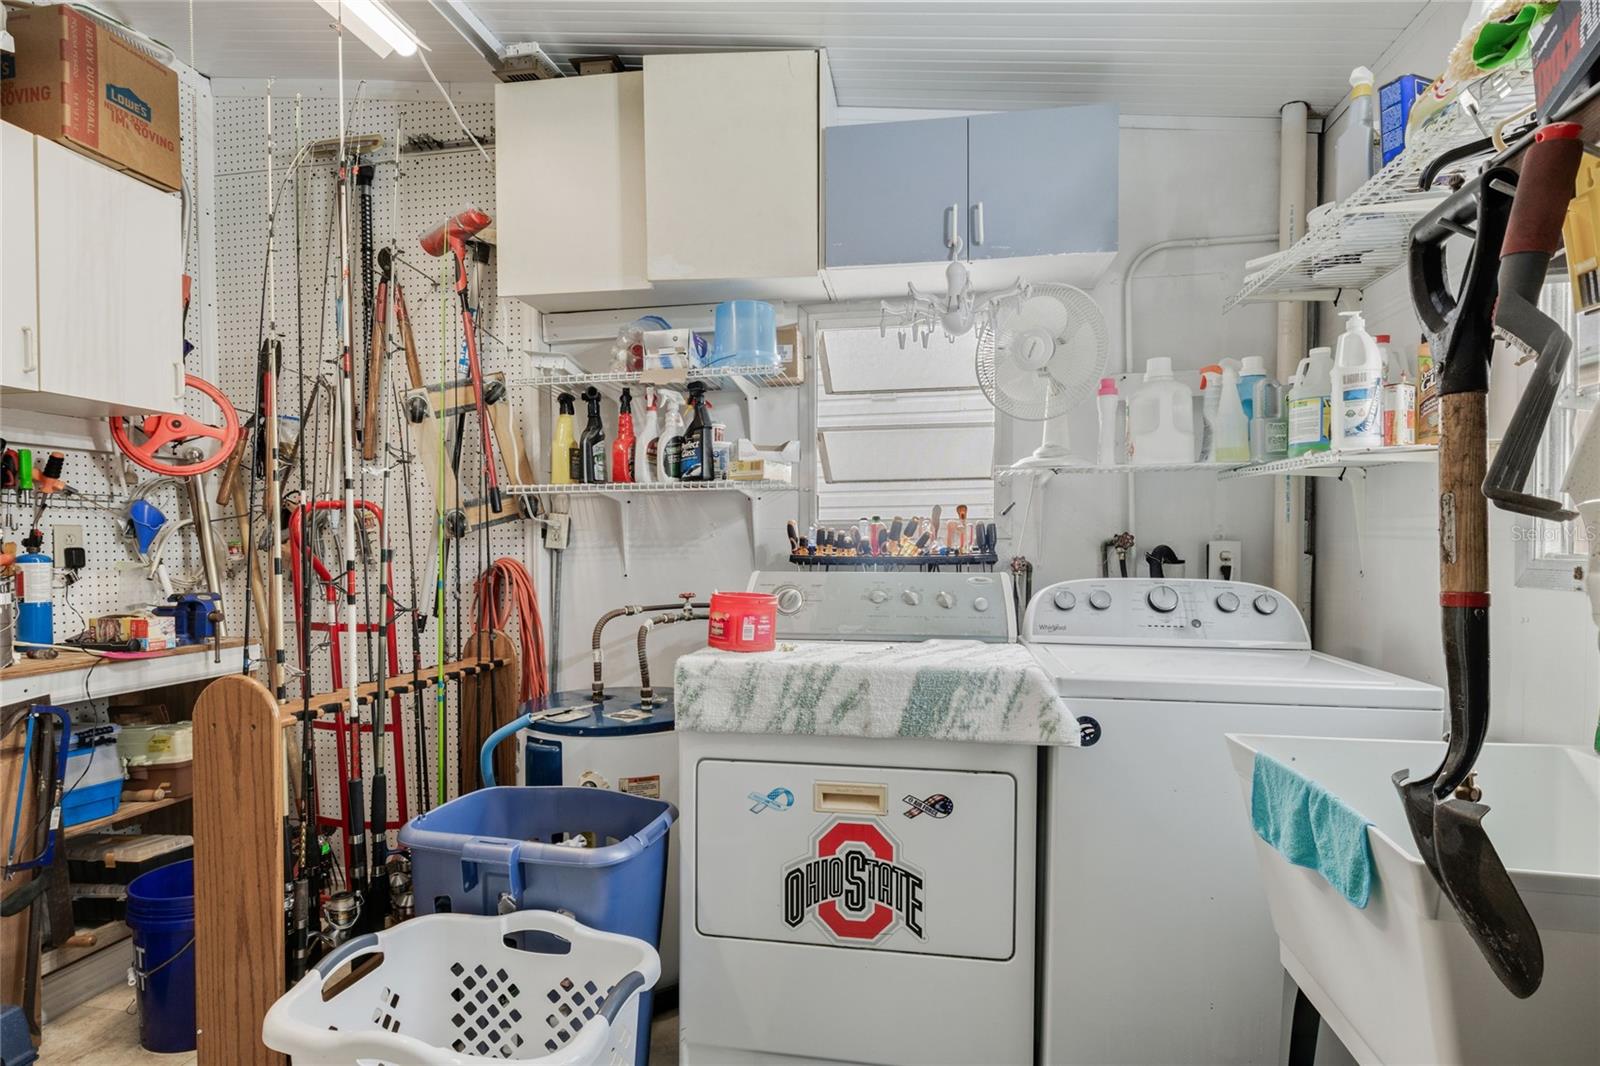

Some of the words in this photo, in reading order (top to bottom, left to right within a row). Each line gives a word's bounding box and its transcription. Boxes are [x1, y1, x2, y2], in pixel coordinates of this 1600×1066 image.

[85, 25, 95, 61] HEAVY
[86, 66, 95, 97] DUTY
[87, 98, 96, 135] SMALL
[111, 88, 148, 117] LOWE'S
